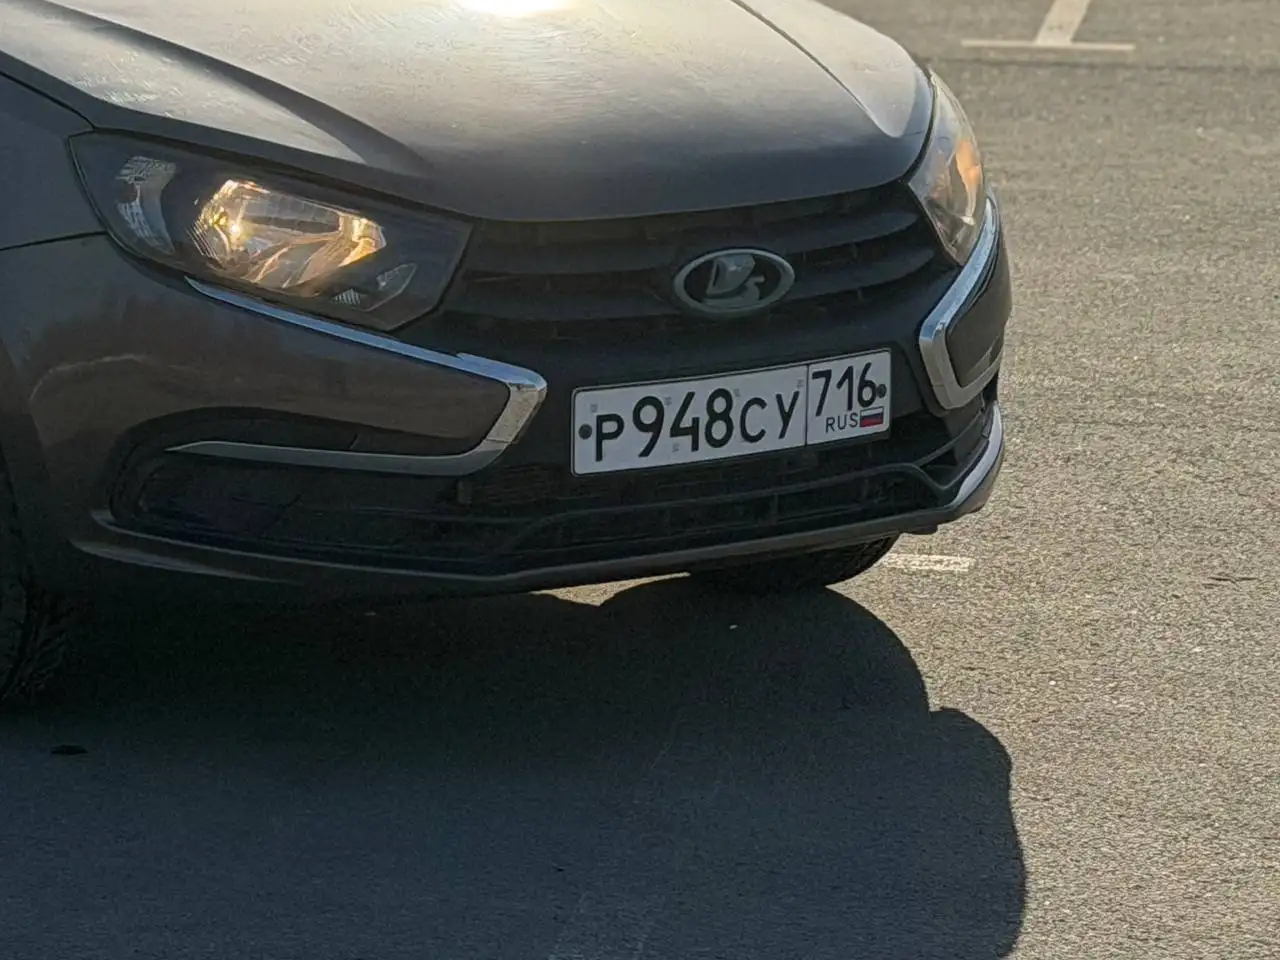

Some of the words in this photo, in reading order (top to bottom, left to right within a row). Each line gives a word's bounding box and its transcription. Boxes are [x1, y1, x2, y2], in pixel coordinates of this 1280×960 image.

[593, 388, 800, 462] Р948СУ
[812, 362, 877, 417] 716
[825, 411, 858, 433] RUS
